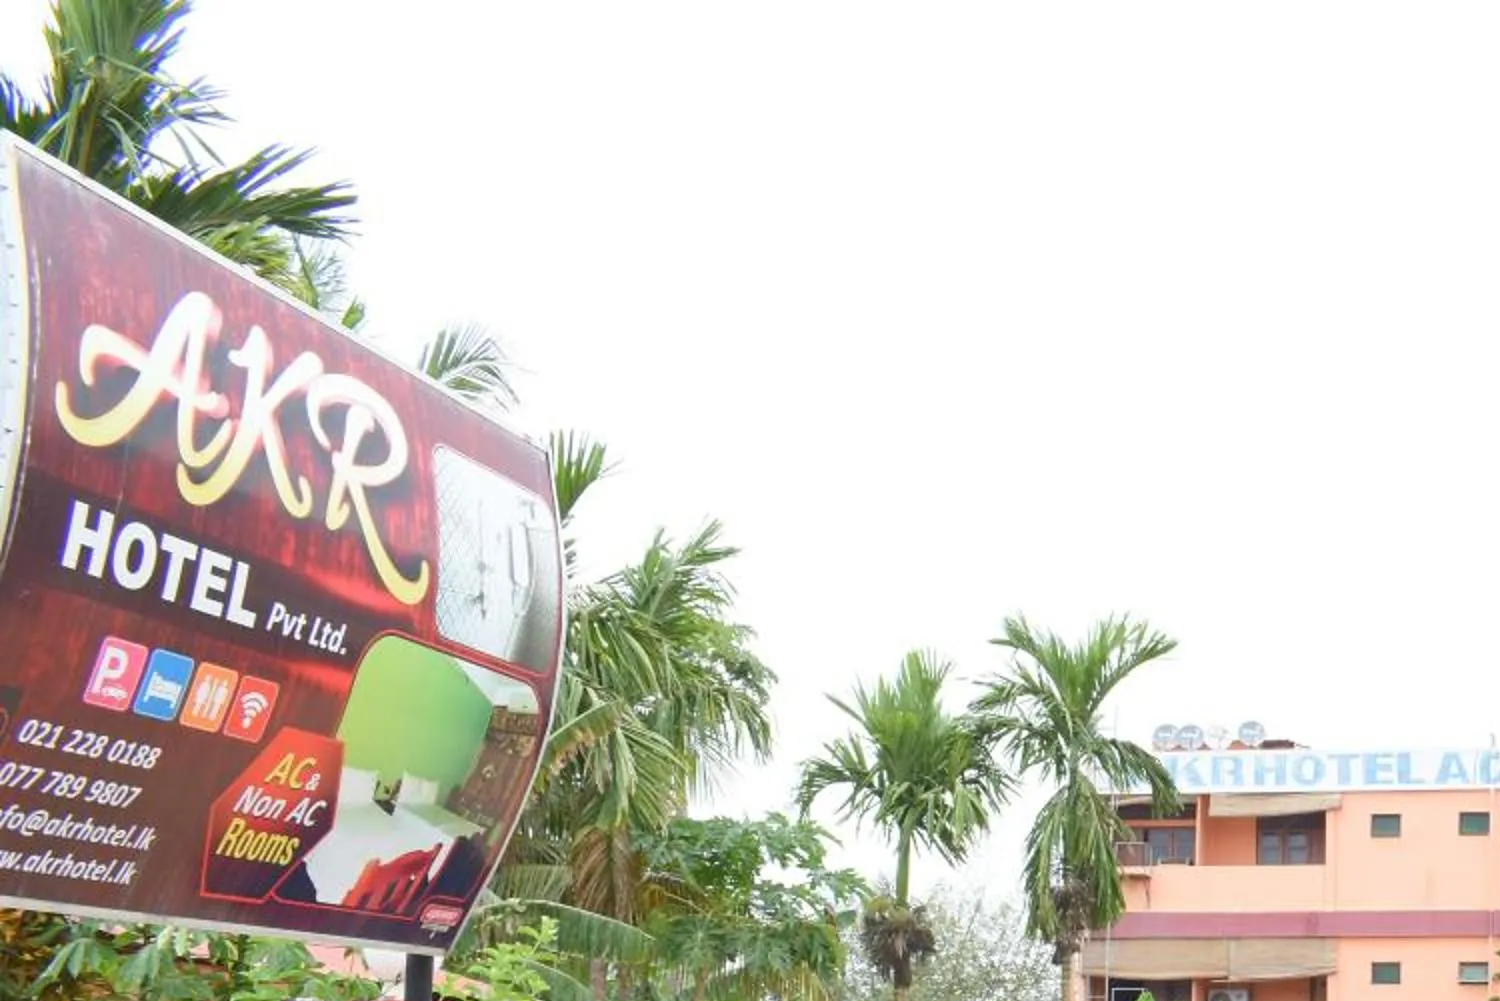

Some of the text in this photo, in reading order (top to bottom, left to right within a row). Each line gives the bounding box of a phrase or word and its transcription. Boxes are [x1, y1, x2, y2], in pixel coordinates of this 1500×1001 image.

[55, 291, 430, 605] AKR
[61, 499, 347, 655] HOTEL Pvt Ltd.
[18, 719, 162, 769] 021 228 0188
[0, 762, 143, 808] 077 789 9807
[264, 752, 321, 791] AC &
[1165, 754, 1245, 787] KR
[1253, 751, 1425, 787] HOTEL
[0, 804, 157, 851] fo@akrhotel.lk
[233, 784, 328, 827] Non AC
[216, 817, 300, 866] Rooms
[0, 848, 137, 886] w.akrhotel.lk
